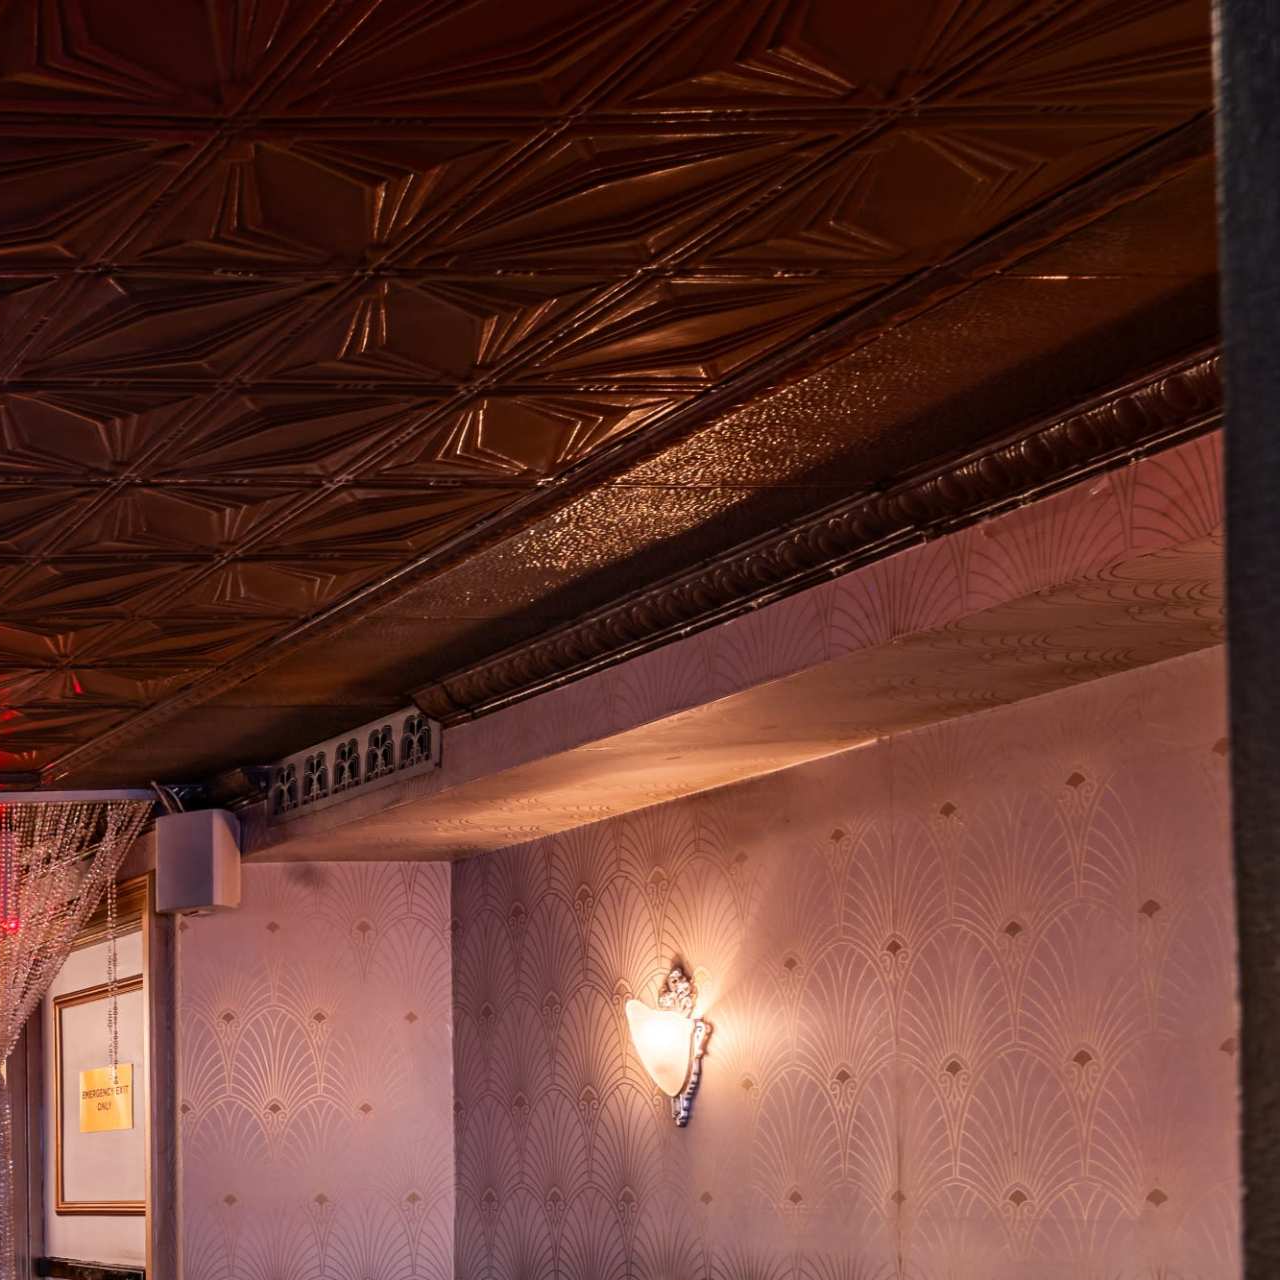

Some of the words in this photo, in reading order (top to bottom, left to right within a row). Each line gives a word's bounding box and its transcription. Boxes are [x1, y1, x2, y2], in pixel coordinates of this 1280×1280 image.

[81, 1087, 114, 1100] EMERGENCY
[115, 1085, 129, 1096] EXIT
[97, 1101, 112, 1112] ONLY
